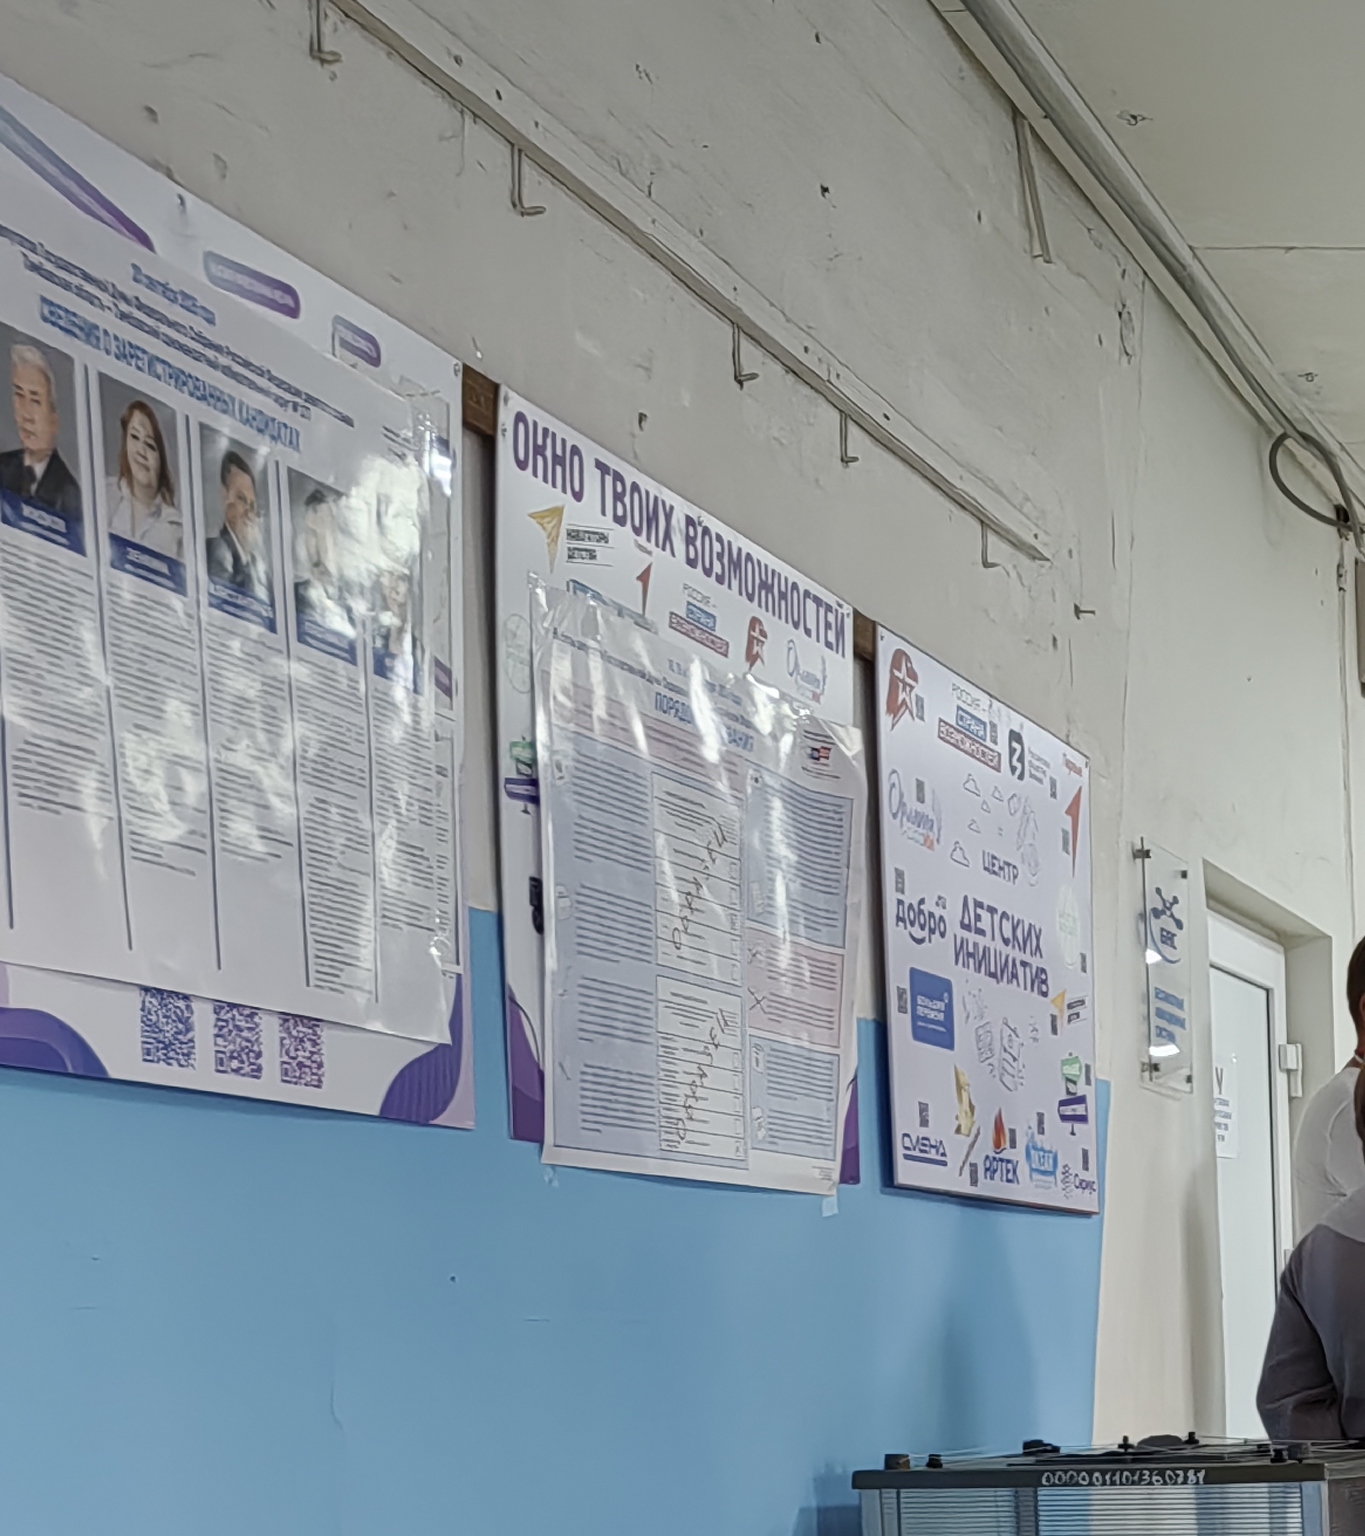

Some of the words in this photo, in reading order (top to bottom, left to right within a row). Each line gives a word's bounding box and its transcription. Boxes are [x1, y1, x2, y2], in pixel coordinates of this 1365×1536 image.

[512, 410, 585, 503] ОКНО
[594, 457, 677, 558] ТВОИХ
[683, 513, 847, 659] ВОЗМОЖНОСТЕЙ
[982, 850, 1019, 885] ЦЕНТР
[960, 894, 1043, 960] ДЕТСКИХ
[953, 933, 1050, 998] ИНИЦИАТИВ
[983, 1154, 1020, 1185] АРТЕК
